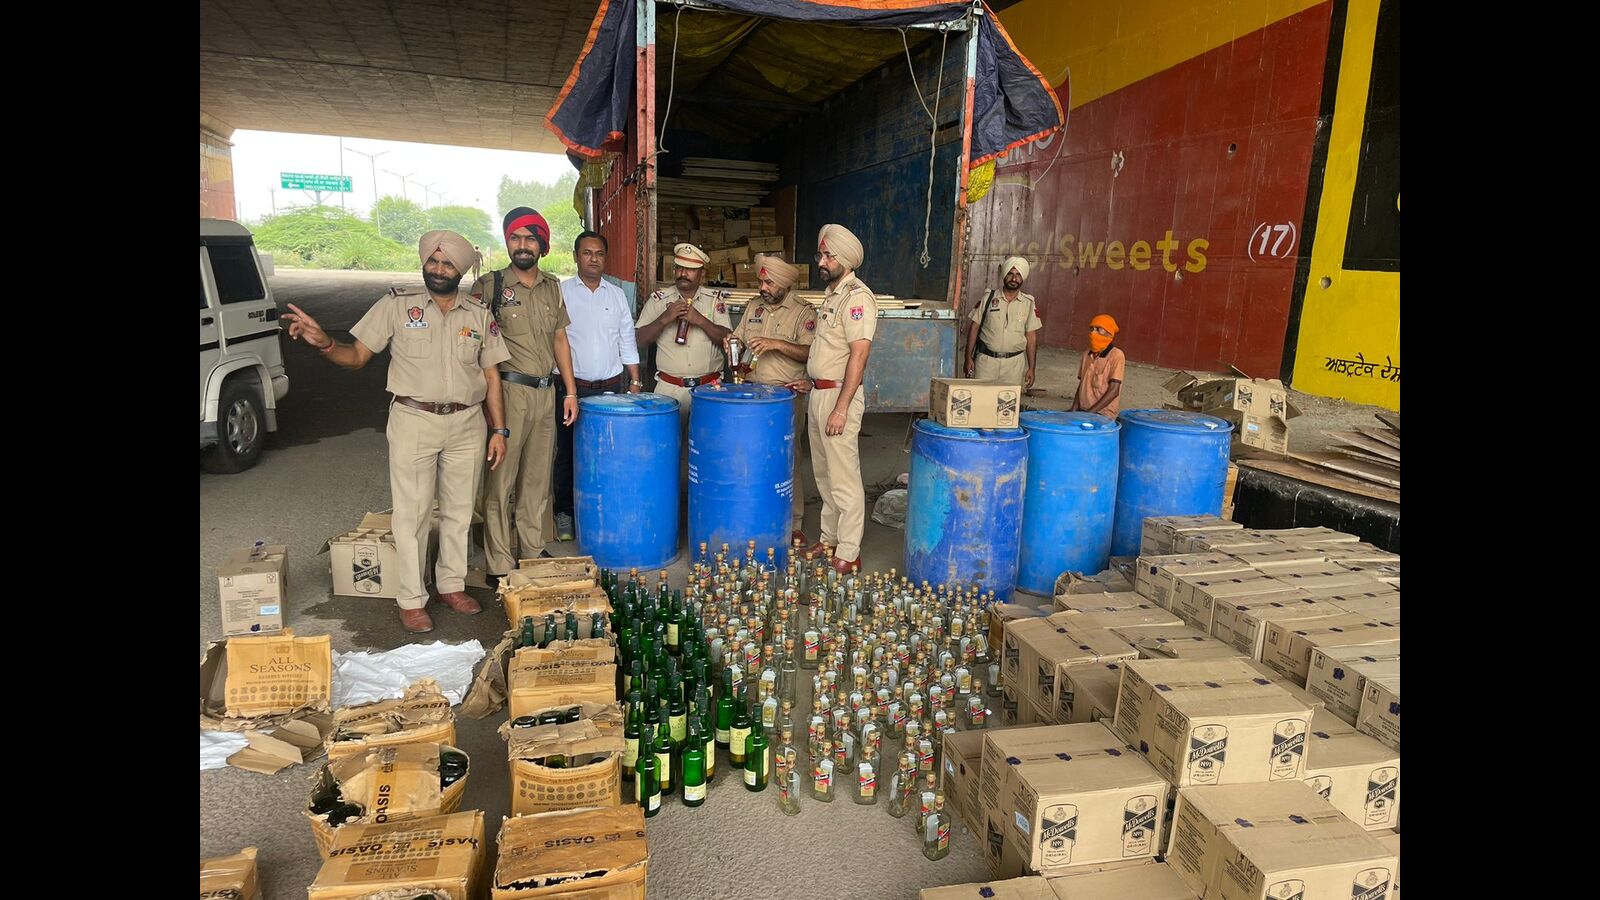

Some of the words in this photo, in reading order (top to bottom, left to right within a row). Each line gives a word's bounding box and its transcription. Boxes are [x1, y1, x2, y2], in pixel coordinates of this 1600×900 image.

[268, 657, 294, 665] ALL
[524, 663, 560, 671] OASIS
[249, 662, 312, 674] SEASONS
[376, 784, 391, 824] OASIS
[428, 838, 479, 848] OASIS
[544, 836, 596, 848] OASIS
[329, 843, 383, 858] OASIS
